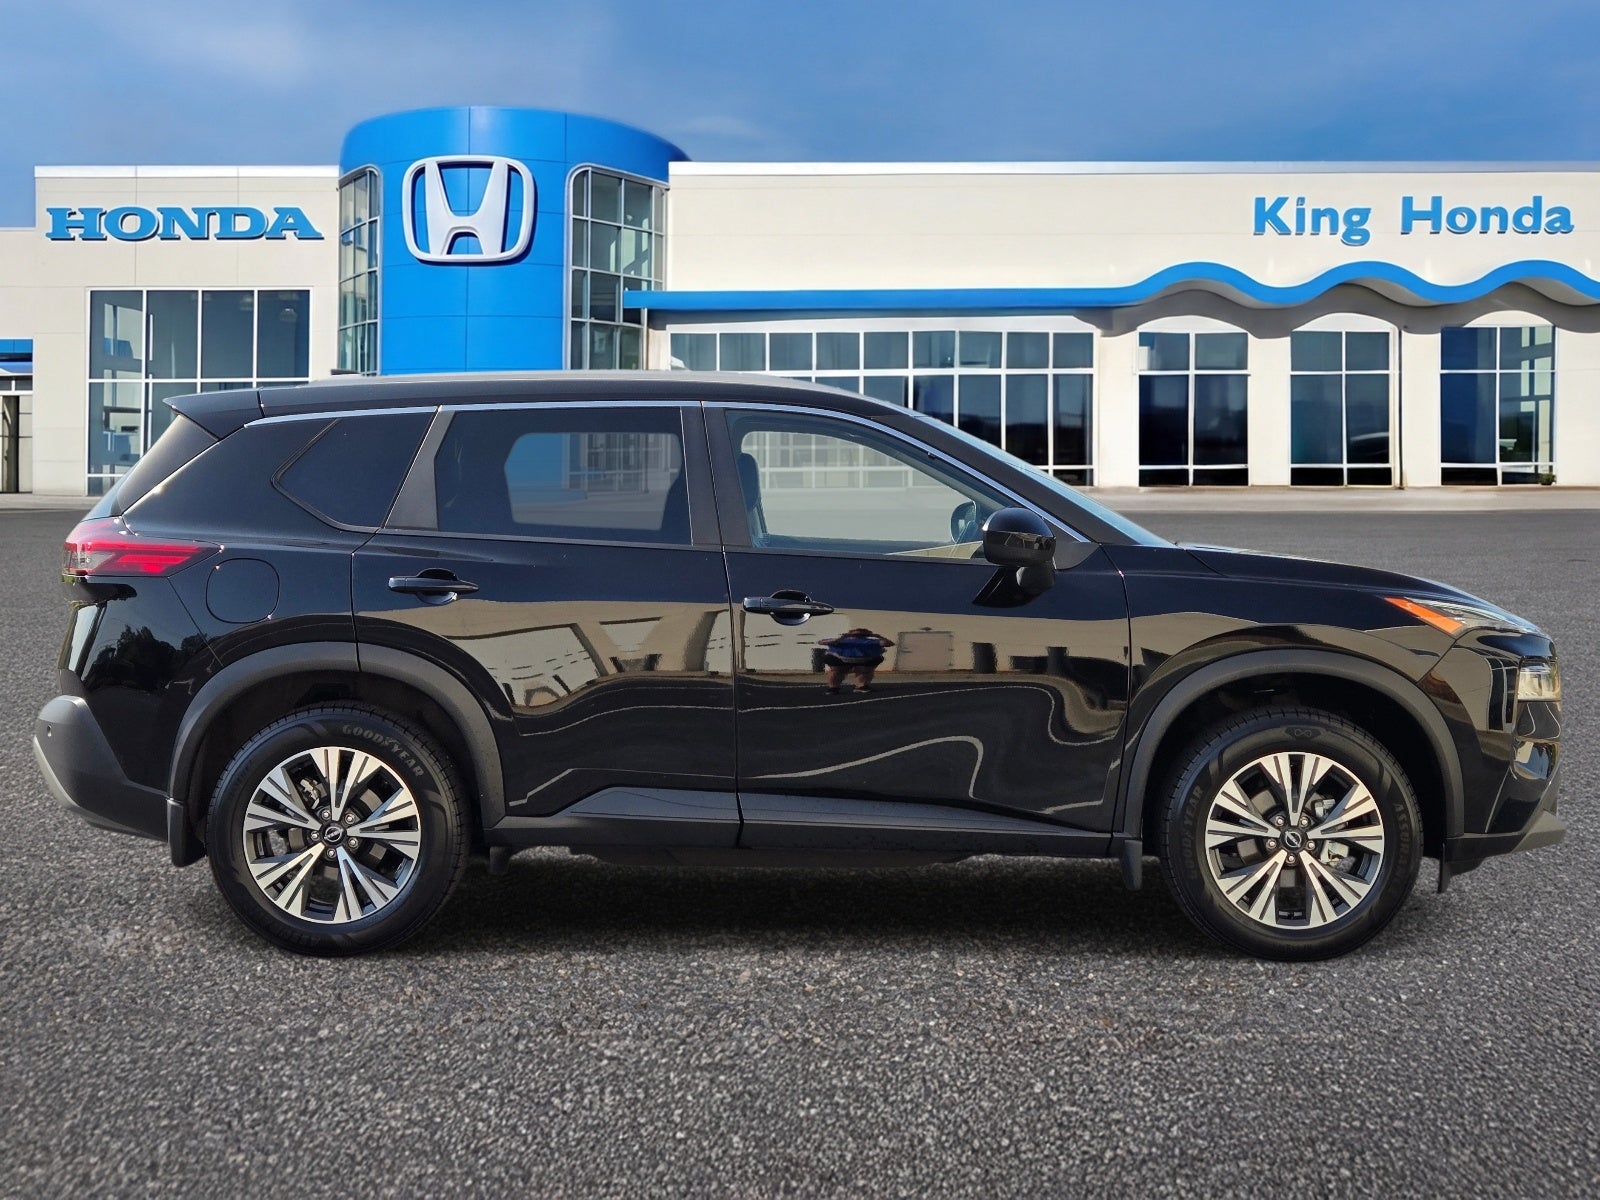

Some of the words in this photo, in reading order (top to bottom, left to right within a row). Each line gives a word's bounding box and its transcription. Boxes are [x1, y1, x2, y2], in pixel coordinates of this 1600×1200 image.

[45, 206, 324, 241] HONDA
[1254, 196, 1371, 246] King
[1401, 196, 1574, 235] Honda
[342, 724, 425, 777] GOODYEAR
[1392, 802, 1411, 893] ASSURAN
